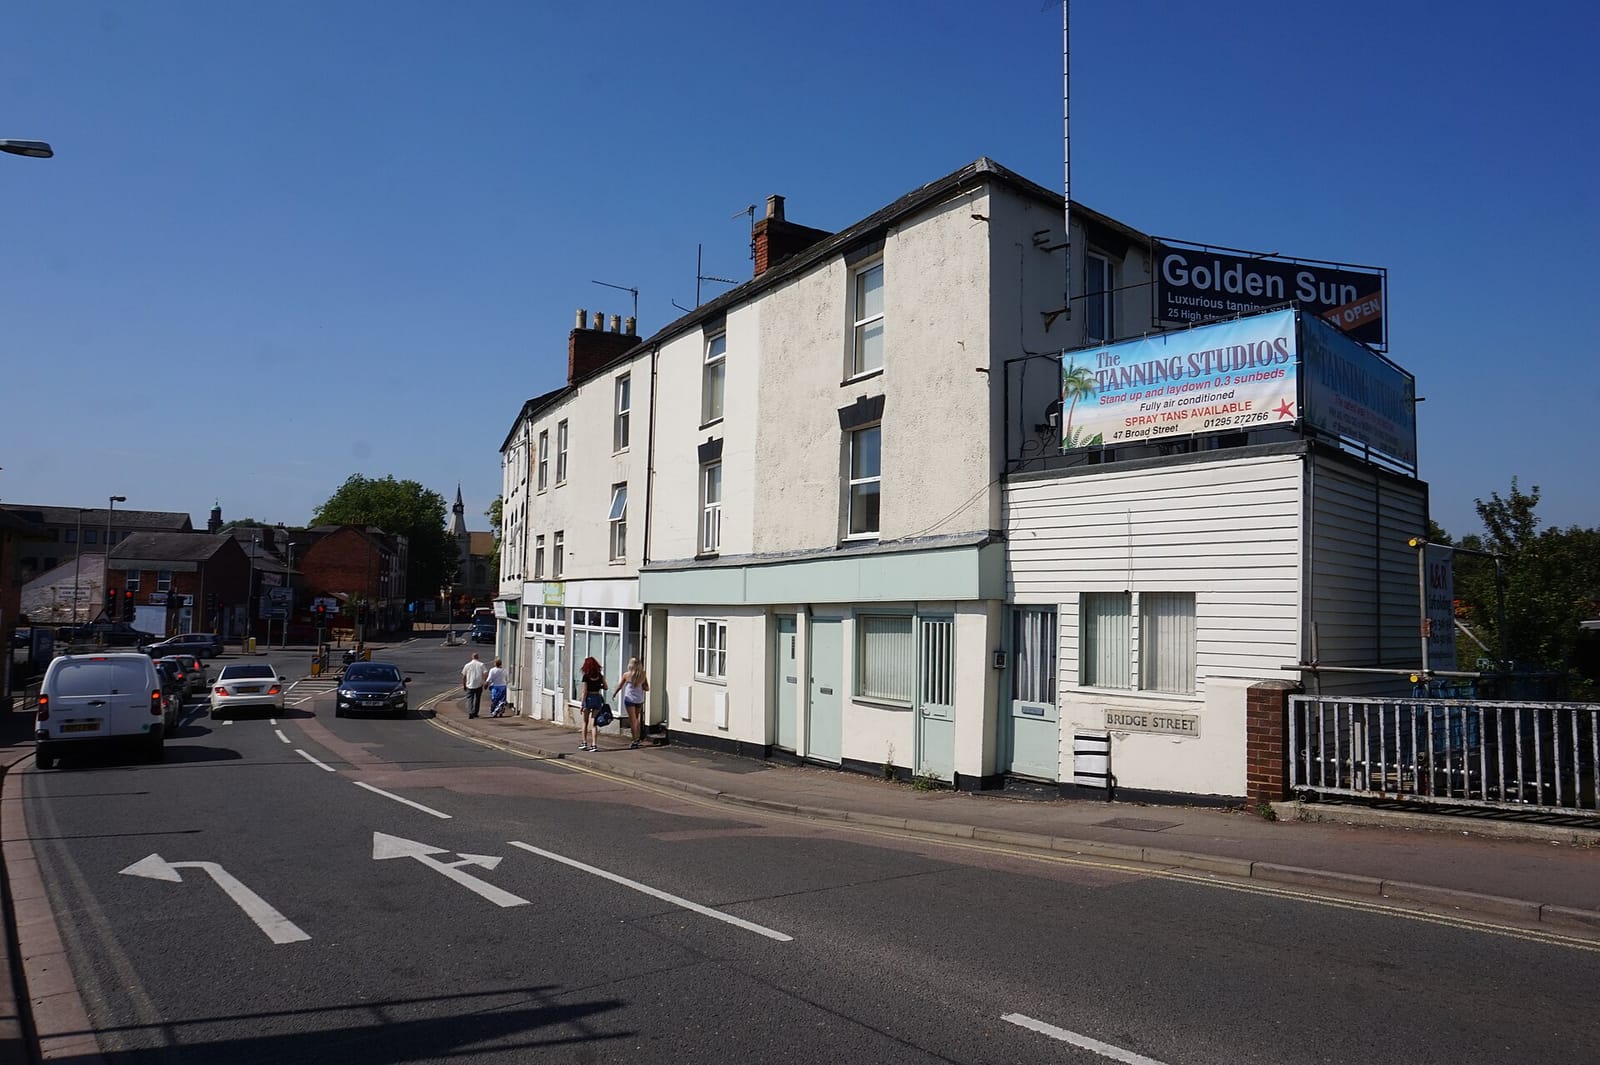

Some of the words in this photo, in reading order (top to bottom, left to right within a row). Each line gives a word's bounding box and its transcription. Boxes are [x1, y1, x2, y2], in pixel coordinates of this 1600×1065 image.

[1162, 253, 1285, 299] Golden
[1295, 270, 1358, 306] Sun
[1167, 291, 1224, 309] Luxurious
[1226, 299, 1266, 313] tannin
[1167, 307, 1179, 318] 25
[1181, 309, 1202, 322] High
[1343, 298, 1381, 323] OPEN
[1095, 356, 1183, 393] TANNING
[1187, 337, 1289, 378] STUDIOS
[1096, 352, 1121, 368] The
[1100, 392, 1127, 405] Stand
[1129, 392, 1142, 403] up
[1145, 387, 1164, 399] and
[1166, 380, 1211, 396] laydown
[1214, 376, 1230, 388] 0.3
[1234, 368, 1285, 384] sunbeds
[1125, 412, 1158, 427] SPRAY
[1160, 408, 1188, 422] TANS
[1190, 400, 1252, 418] AVAILABLE
[1140, 401, 1162, 413] Fully
[1163, 398, 1175, 408] air
[1177, 389, 1235, 406] conditioned
[1113, 430, 1123, 440] 47
[1125, 426, 1151, 438] Broad
[1152, 423, 1179, 435] Street
[1204, 415, 1232, 428] 01295
[1234, 411, 1269, 425] 272766
[1107, 713, 1148, 727] BRIDGE
[1152, 717, 1195, 731] STREET
